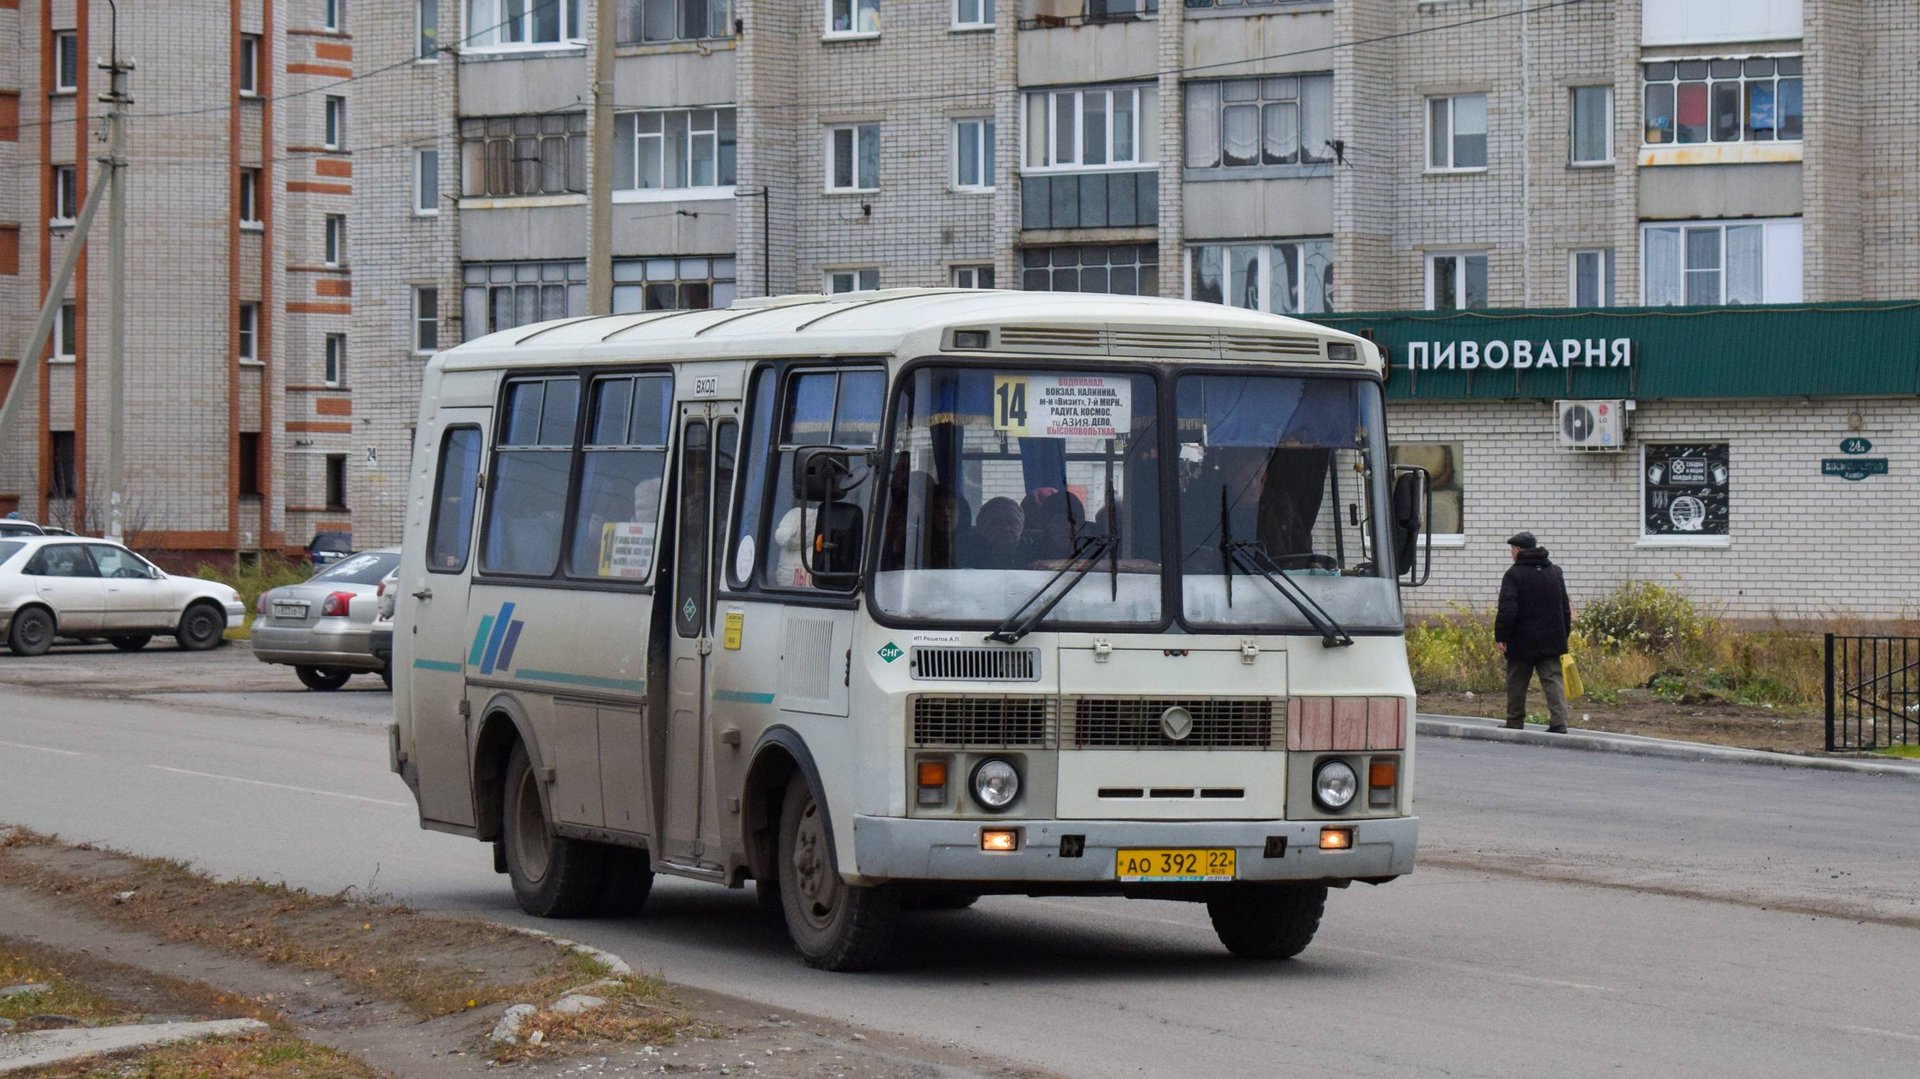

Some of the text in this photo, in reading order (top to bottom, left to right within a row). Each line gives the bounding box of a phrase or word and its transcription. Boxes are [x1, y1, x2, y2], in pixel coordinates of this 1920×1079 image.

[1408, 338, 1631, 370] ПИВОВАРНЯ
[696, 379, 715, 394] ВХОД
[997, 383, 1027, 426] 14
[367, 447, 377, 461] 24
[881, 648, 900, 657] СНГ
[1127, 852, 1228, 873] АО 392 22
